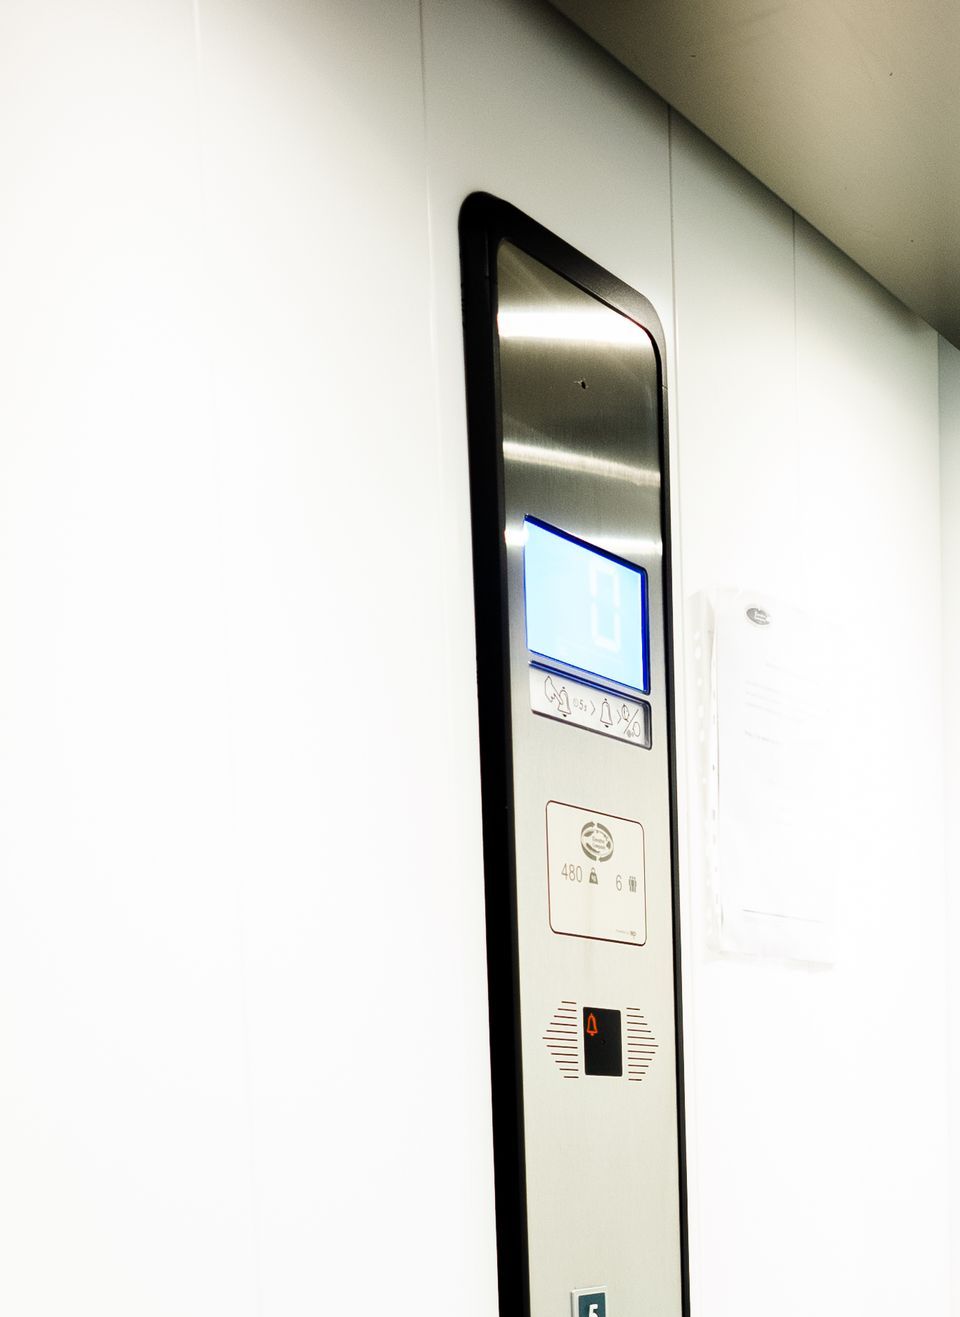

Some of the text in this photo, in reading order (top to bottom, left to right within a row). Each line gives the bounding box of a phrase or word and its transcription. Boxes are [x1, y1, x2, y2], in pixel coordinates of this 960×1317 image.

[592, 560, 619, 652] 0
[561, 862, 583, 883] 480
[615, 874, 622, 892] 6
